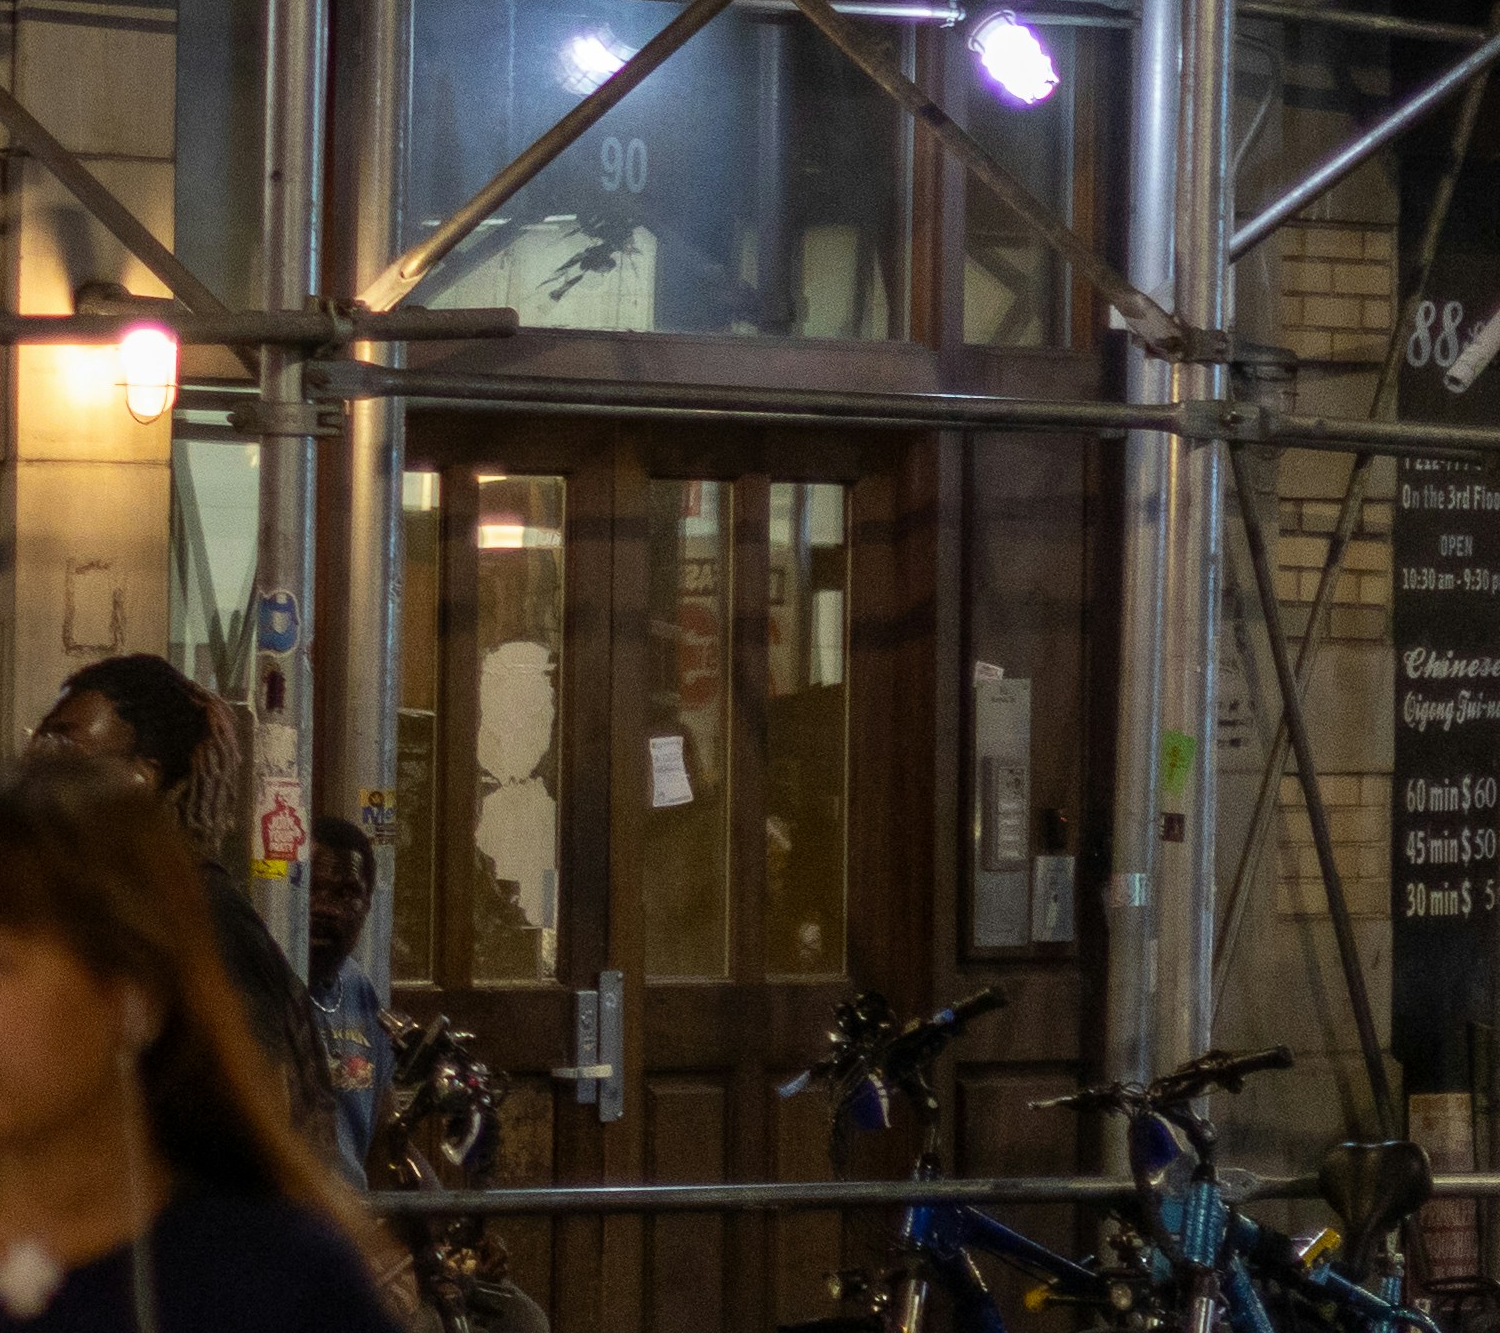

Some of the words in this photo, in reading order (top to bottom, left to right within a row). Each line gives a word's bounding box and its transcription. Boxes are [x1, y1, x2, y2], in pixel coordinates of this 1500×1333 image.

[599, 136, 649, 193] 90
[1406, 300, 1464, 368] 88
[1402, 484, 1420, 510] On
[1422, 484, 1445, 510] the
[1447, 484, 1471, 510] 3rd
[1439, 534, 1473, 558] OPEN
[1402, 568, 1436, 591] 10:30
[1464, 568, 1490, 591] 9:30
[1403, 646, 1500, 679] Chinese
[1406, 778, 1426, 813] 60
[1429, 778, 1459, 812] min
[1406, 830, 1426, 865] 45
[1429, 830, 1459, 864] min
[1406, 882, 1426, 918] 30
[1429, 882, 1459, 917] min
